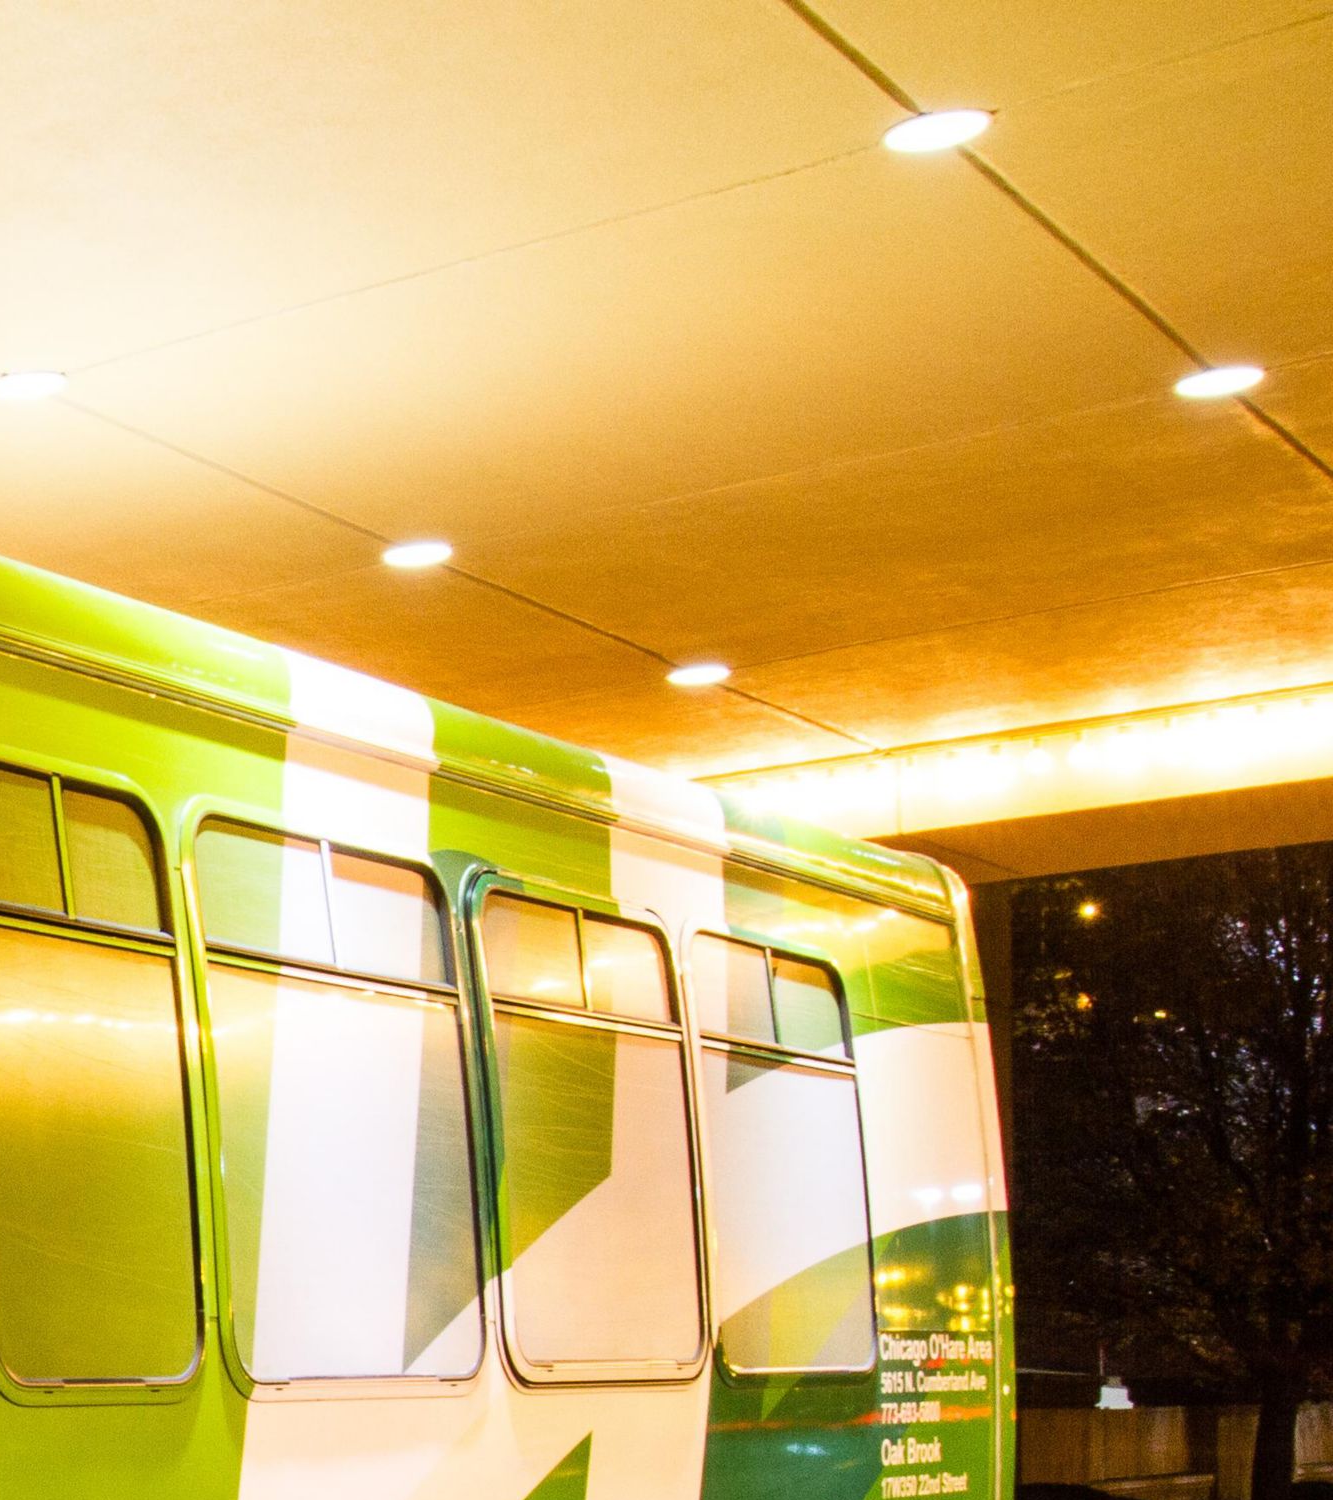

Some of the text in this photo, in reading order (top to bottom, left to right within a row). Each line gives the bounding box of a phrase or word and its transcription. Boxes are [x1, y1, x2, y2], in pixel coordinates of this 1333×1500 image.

[880, 1333, 993, 1366] Chicago O'Hare Area
[880, 1371, 904, 1394] 5615
[917, 1371, 969, 1392] Cumberland
[970, 1371, 987, 1391] Ave
[881, 1436, 942, 1467] Oak Brook
[942, 1472, 968, 1494] Street
